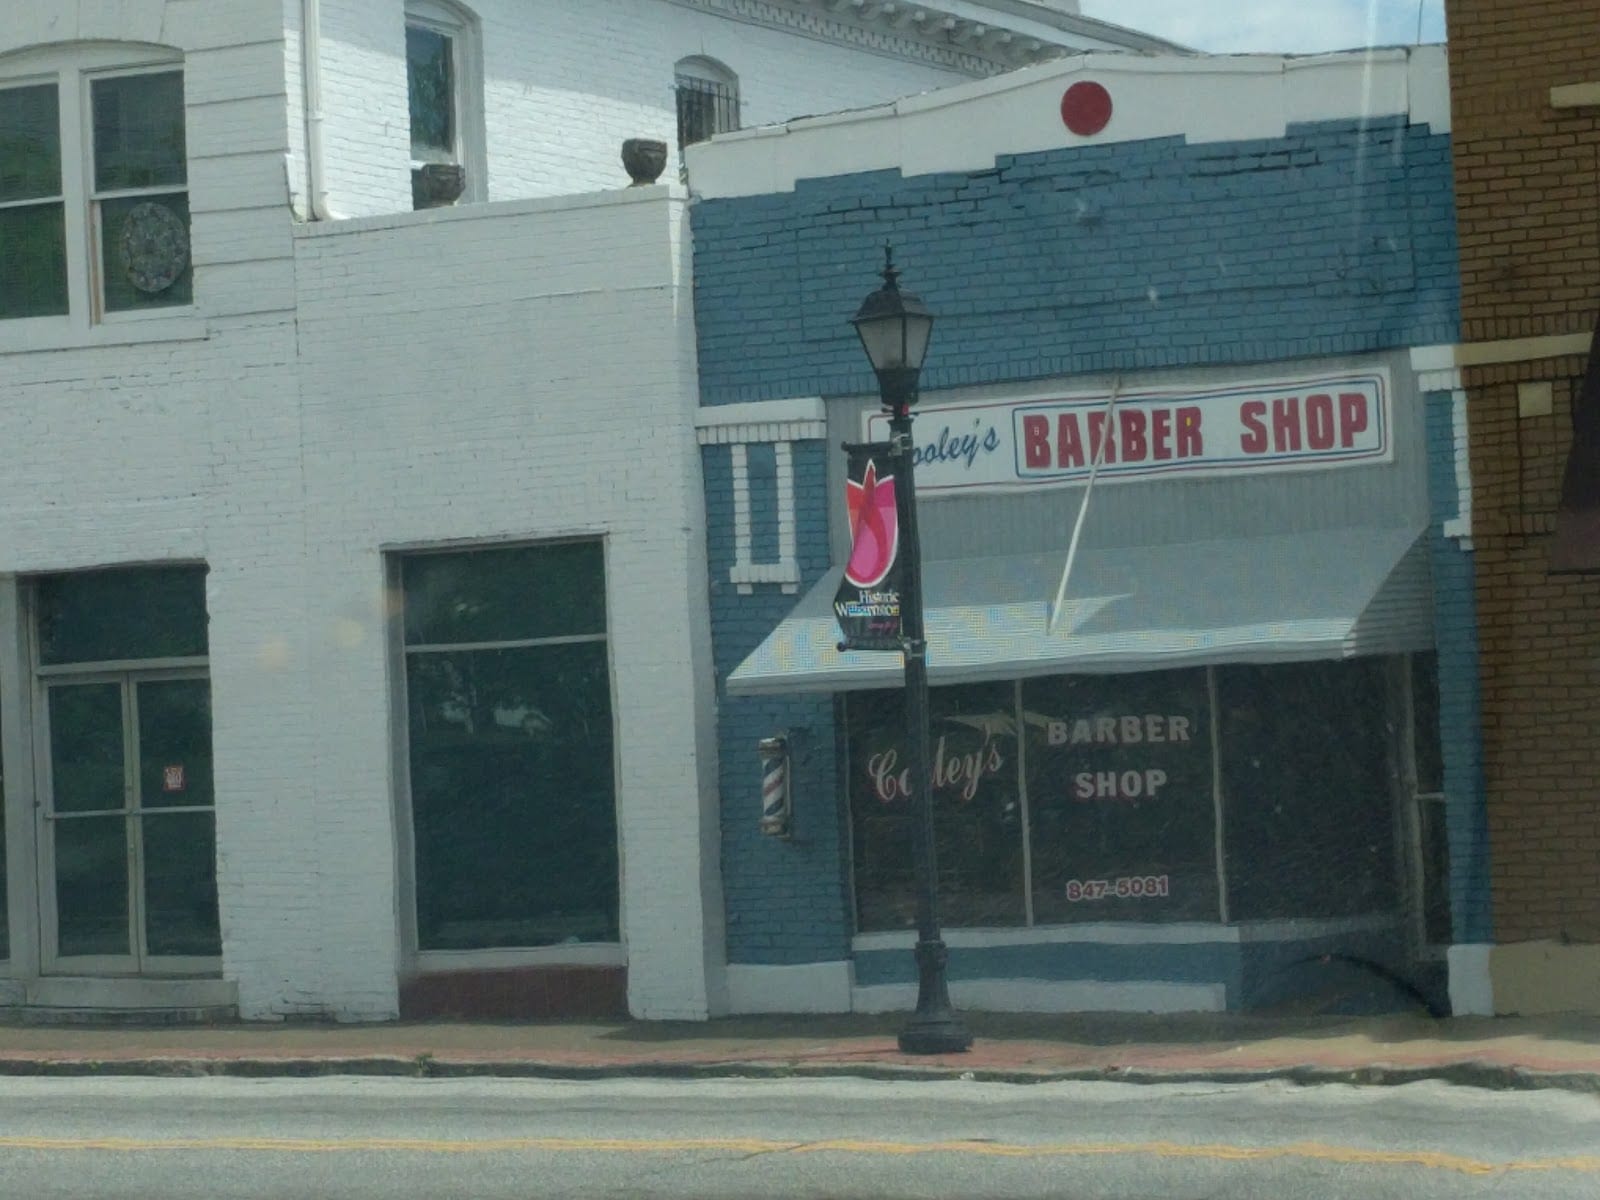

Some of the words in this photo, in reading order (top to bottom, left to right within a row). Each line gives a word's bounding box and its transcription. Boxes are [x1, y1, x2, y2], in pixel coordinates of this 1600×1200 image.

[1023, 405, 1204, 469] BARBER
[1239, 393, 1368, 454] SHOP
[1047, 715, 1190, 745] BARBER
[1074, 769, 1168, 799] SHOP
[1066, 874, 1169, 902] 847-5081
